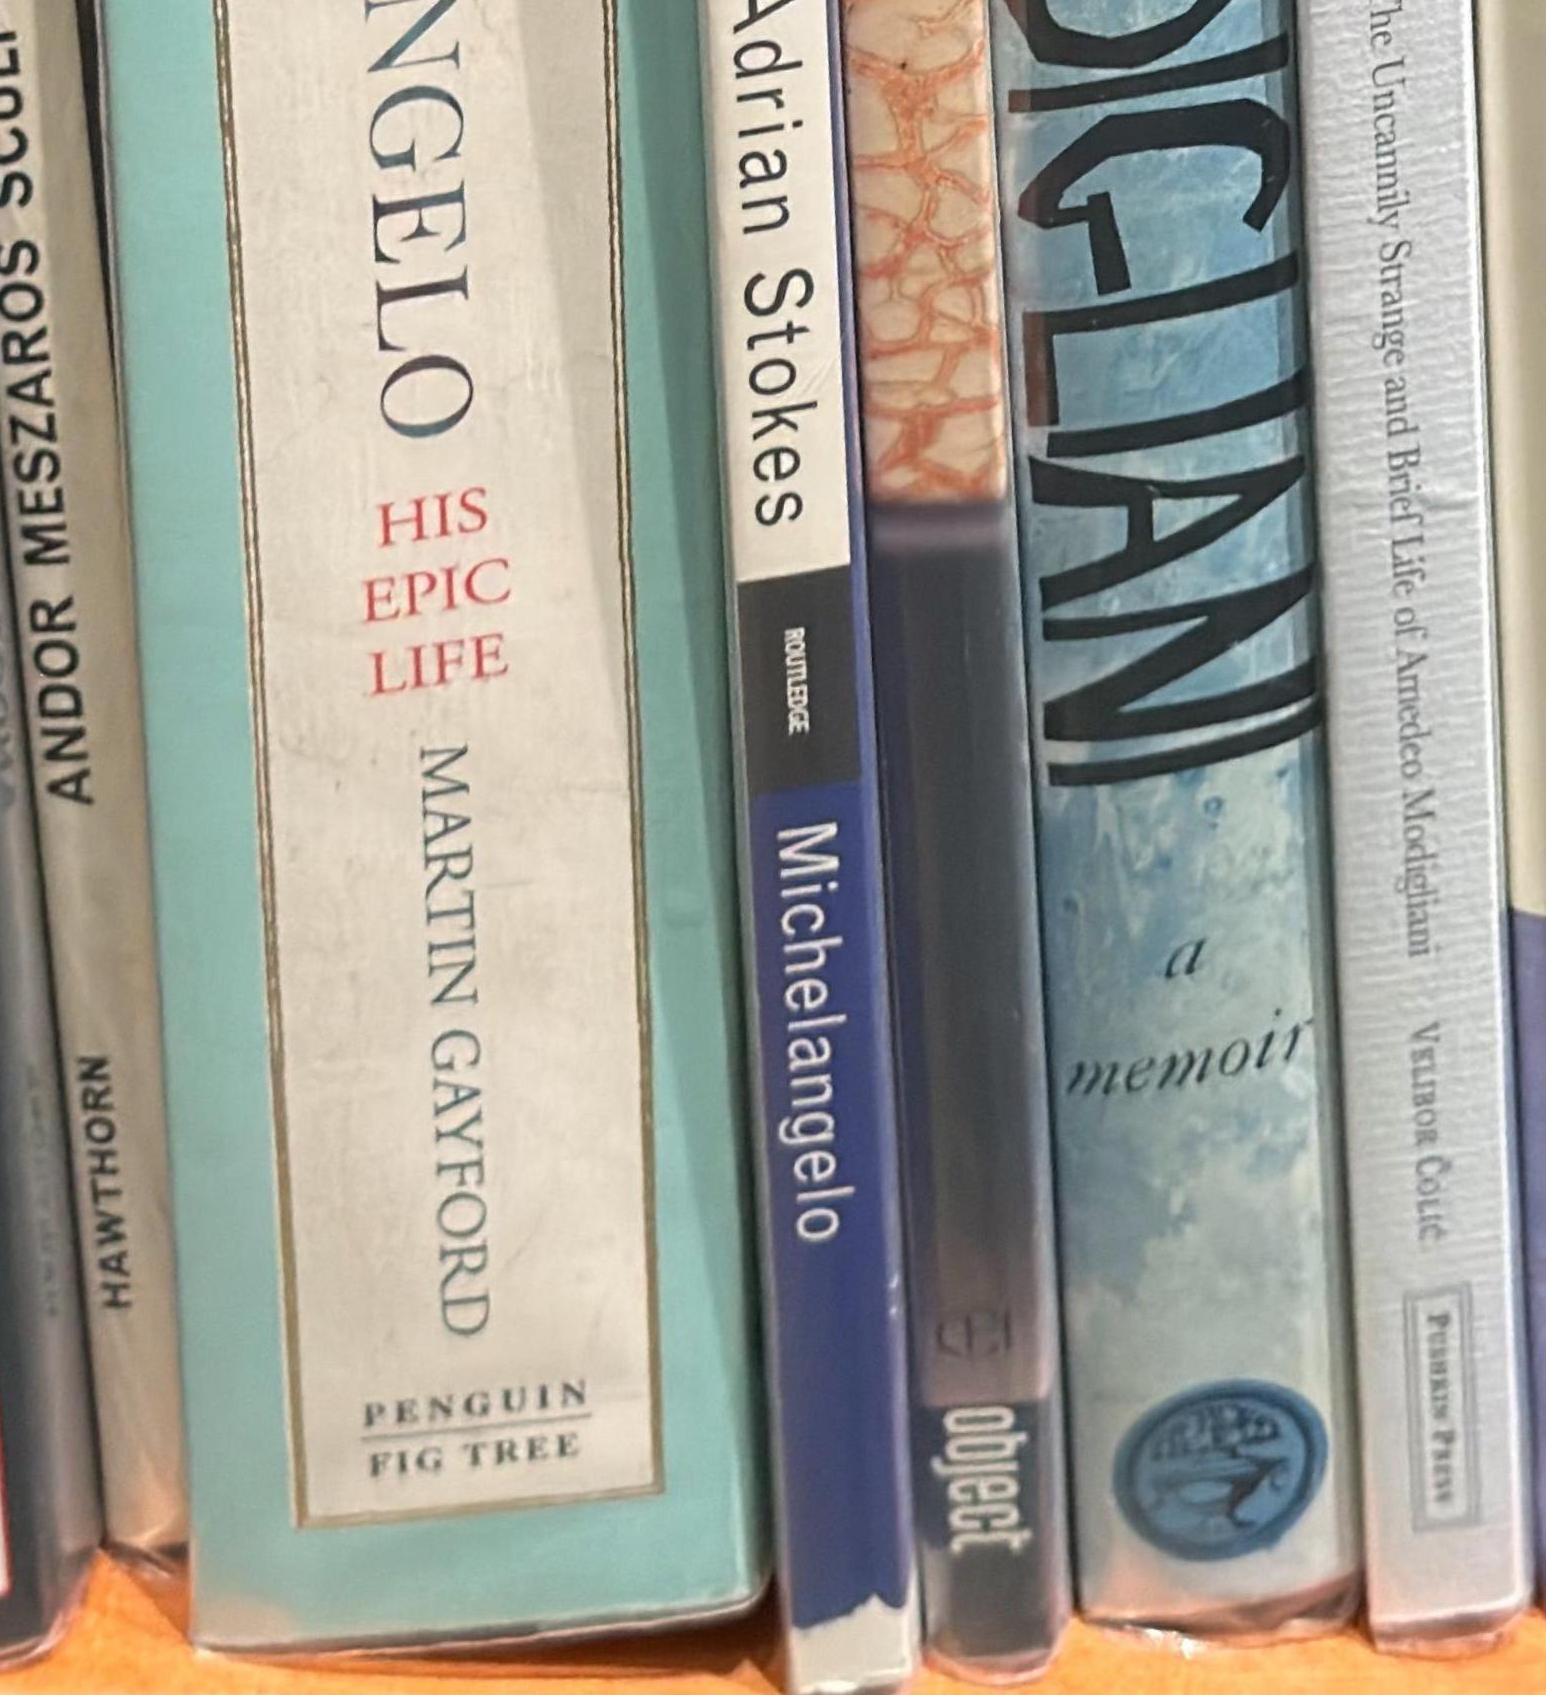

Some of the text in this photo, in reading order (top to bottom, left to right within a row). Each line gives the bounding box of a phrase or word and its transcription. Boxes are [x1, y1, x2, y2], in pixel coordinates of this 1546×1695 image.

[1369, 55, 1410, 229] Uncannily
[1372, 239, 1413, 366] Strange
[743, 266, 819, 528] Stokes
[1384, 376, 1420, 439] and
[376, 486, 489, 550] HIS
[1387, 440, 1425, 524] Brief
[361, 557, 512, 625] EPIC
[1390, 533, 1426, 596] Life
[369, 633, 510, 700] LIFE
[1393, 606, 1426, 639] of
[30, 595, 95, 805] ANDOR
[784, 627, 811, 736] ROUTLEDGE
[1395, 647, 1432, 781] Amedeo
[1395, 786, 1442, 959] Modigliani
[1164, 936, 1209, 980] a
[420, 742, 492, 1341] MARTIN GAYFORD
[776, 821, 856, 1243] Michelangelo
[1066, 1007, 1315, 1097] memoir
[76, 1056, 133, 1310] HAWTHORN
[364, 1379, 589, 1429] PENGUIN
[368, 1432, 581, 1480] FIG TREE
[930, 1404, 1034, 1554] object
